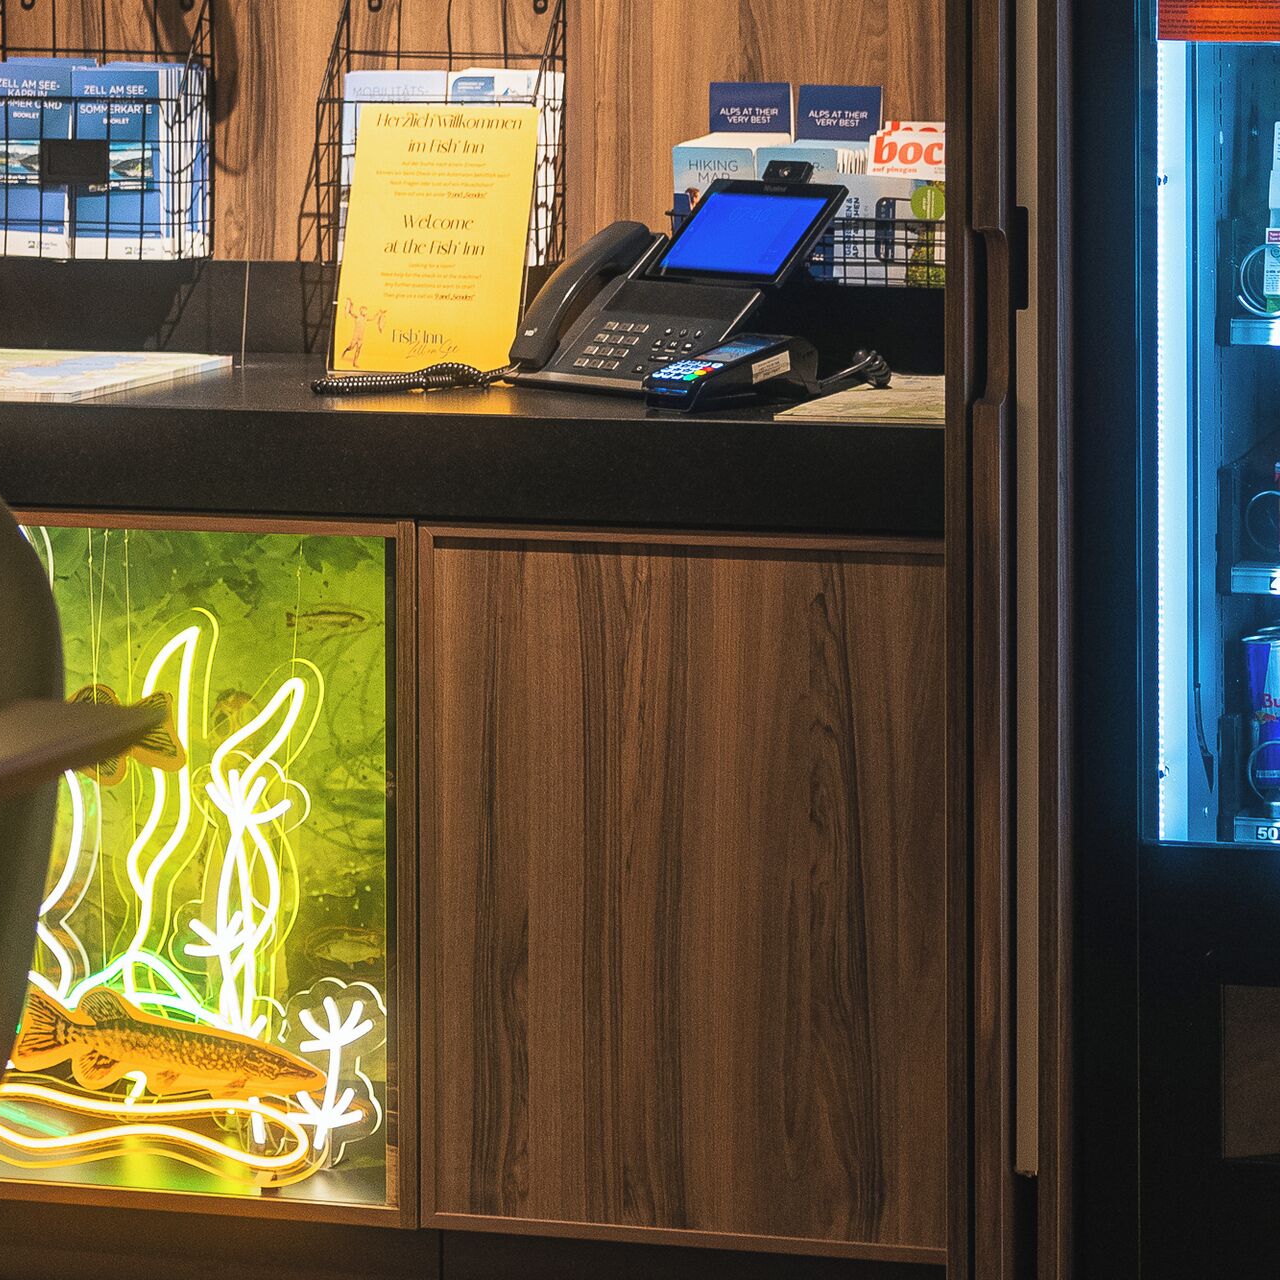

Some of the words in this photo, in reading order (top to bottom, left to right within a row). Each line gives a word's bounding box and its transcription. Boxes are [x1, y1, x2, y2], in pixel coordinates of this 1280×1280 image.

[21, 79, 36, 89] AM
[84, 85, 106, 95] ZELL
[109, 85, 124, 95] AM
[720, 107, 741, 116] ALPS
[755, 108, 778, 116] THEIR
[808, 110, 829, 118] ALPS
[831, 110, 842, 118] AT
[844, 111, 868, 119] THEIR
[103, 117, 129, 125] BOKLET
[376, 112, 434, 128] Herzlich
[435, 113, 522, 130] Willkommen
[816, 118, 838, 126] VERY
[840, 119, 860, 127] BEST
[408, 140, 426, 153] im
[463, 140, 485, 154] Inn
[873, 136, 943, 166] boc
[688, 160, 738, 172] HIKING
[403, 214, 474, 231] Welcome
[384, 240, 399, 254] at
[402, 238, 427, 254] the
[463, 241, 485, 256] Inn
[1257, 827, 1278, 840] 50
